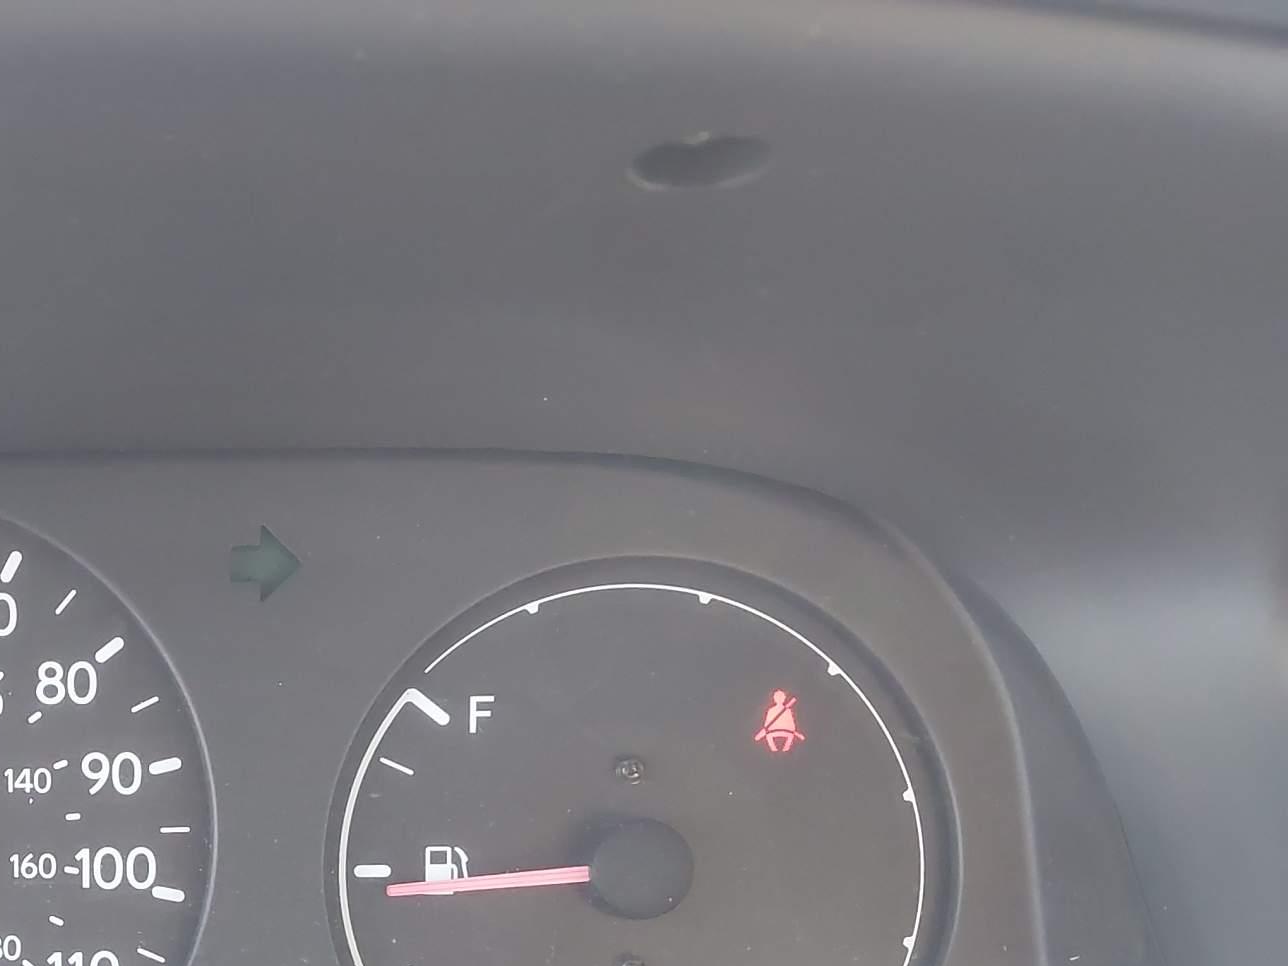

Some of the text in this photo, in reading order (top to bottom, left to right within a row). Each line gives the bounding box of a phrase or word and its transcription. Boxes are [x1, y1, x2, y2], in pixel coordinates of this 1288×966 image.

[35, 661, 97, 705] 80
[469, 695, 495, 733] F
[4, 768, 52, 793] 140
[81, 752, 142, 795] 90
[10, 853, 56, 879] 160
[75, 847, 156, 890] 100
